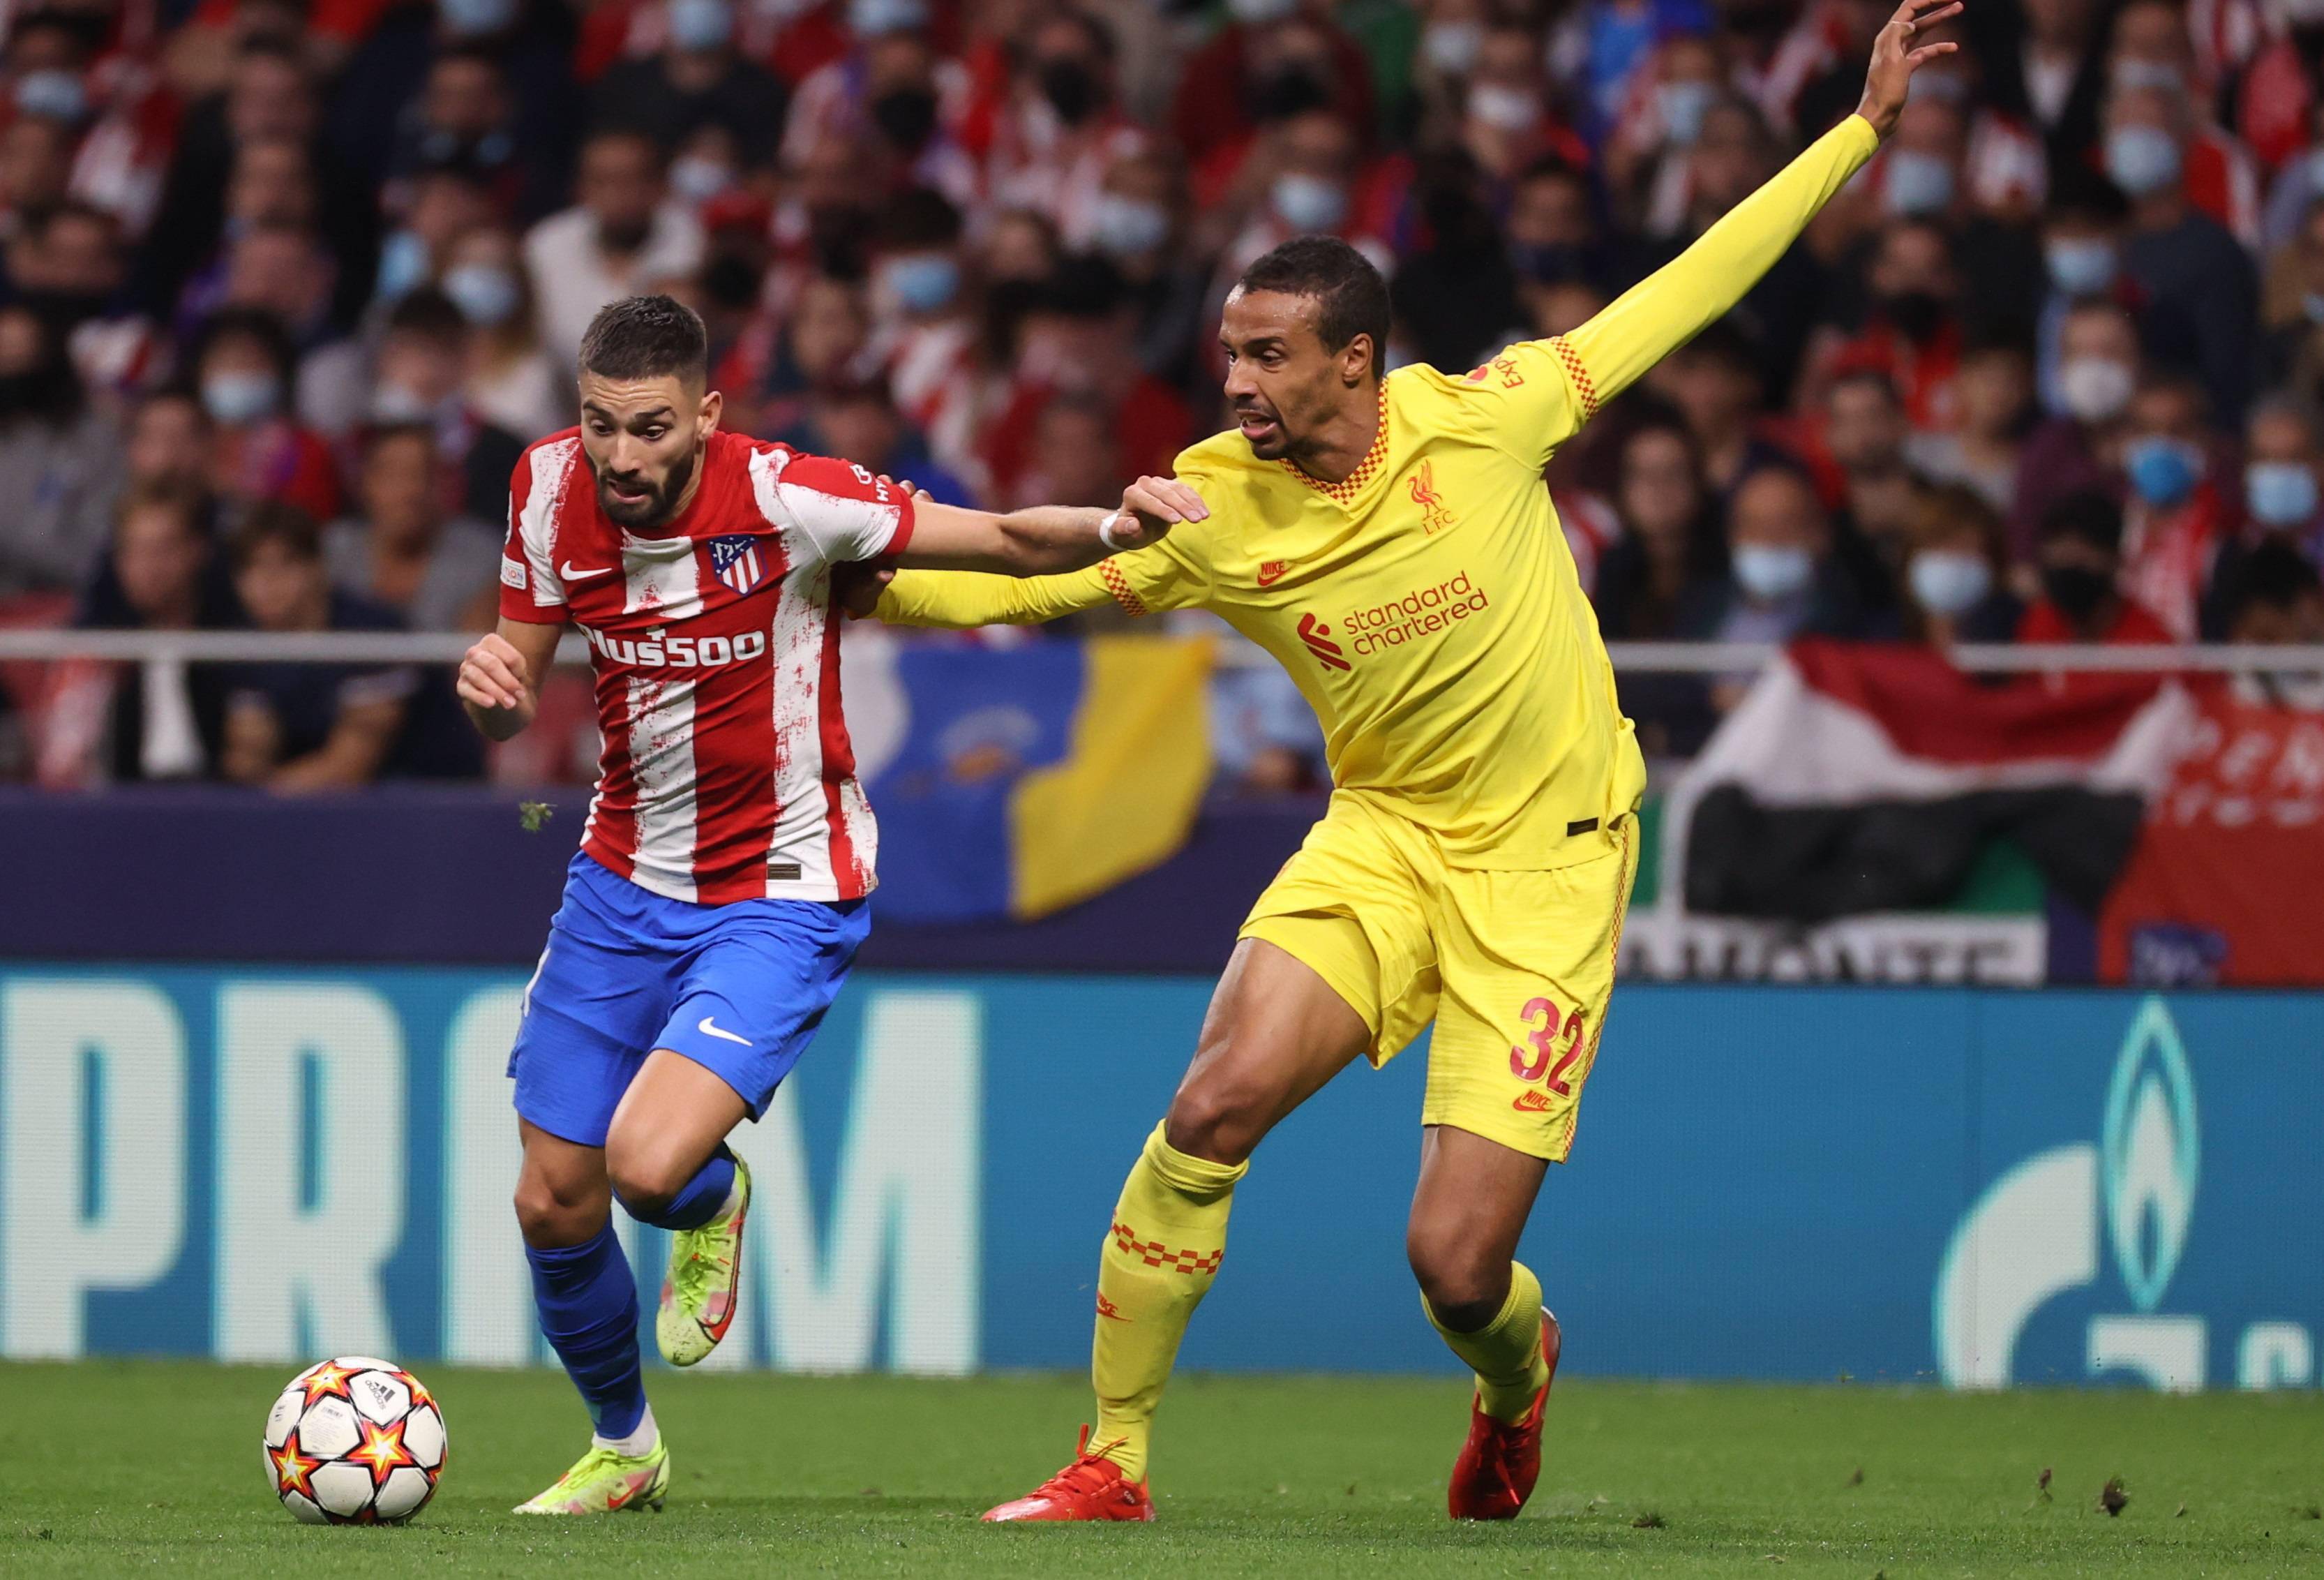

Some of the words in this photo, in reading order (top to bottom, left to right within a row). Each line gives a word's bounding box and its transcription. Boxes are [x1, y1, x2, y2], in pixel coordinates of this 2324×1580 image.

[1260, 561, 1286, 575] NIKE
[1343, 569, 1472, 635] standard
[1354, 588, 1489, 655] chartered
[1508, 997, 1586, 1099] 32
[1522, 1089, 1552, 1111] NIKE
